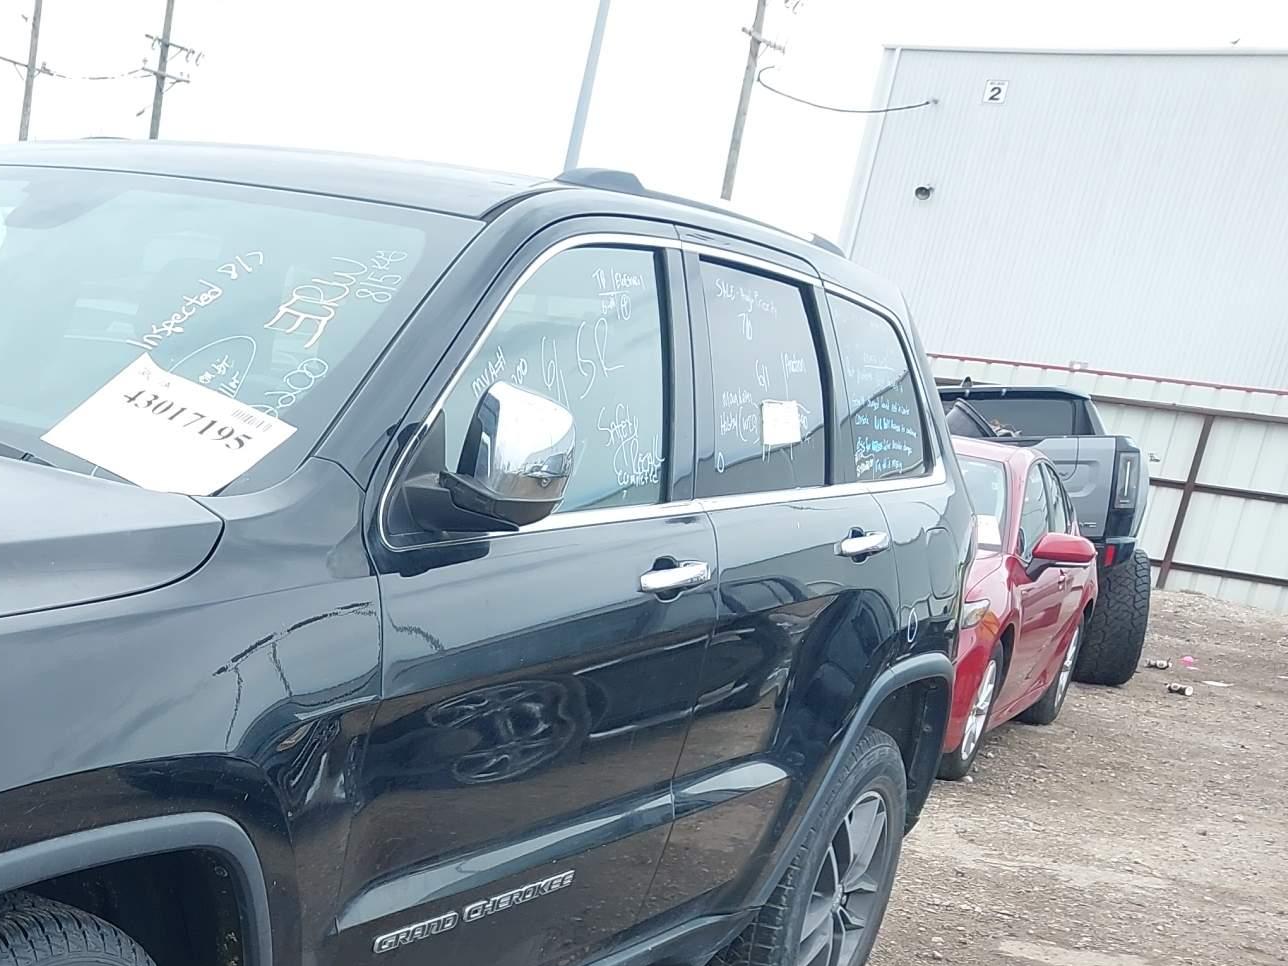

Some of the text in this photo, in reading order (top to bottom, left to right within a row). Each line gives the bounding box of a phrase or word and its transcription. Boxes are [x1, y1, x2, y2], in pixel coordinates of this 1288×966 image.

[988, 86, 1002, 101] 2
[123, 389, 253, 451] 43017195
[373, 869, 576, 955] GRAND CHEROKEE
